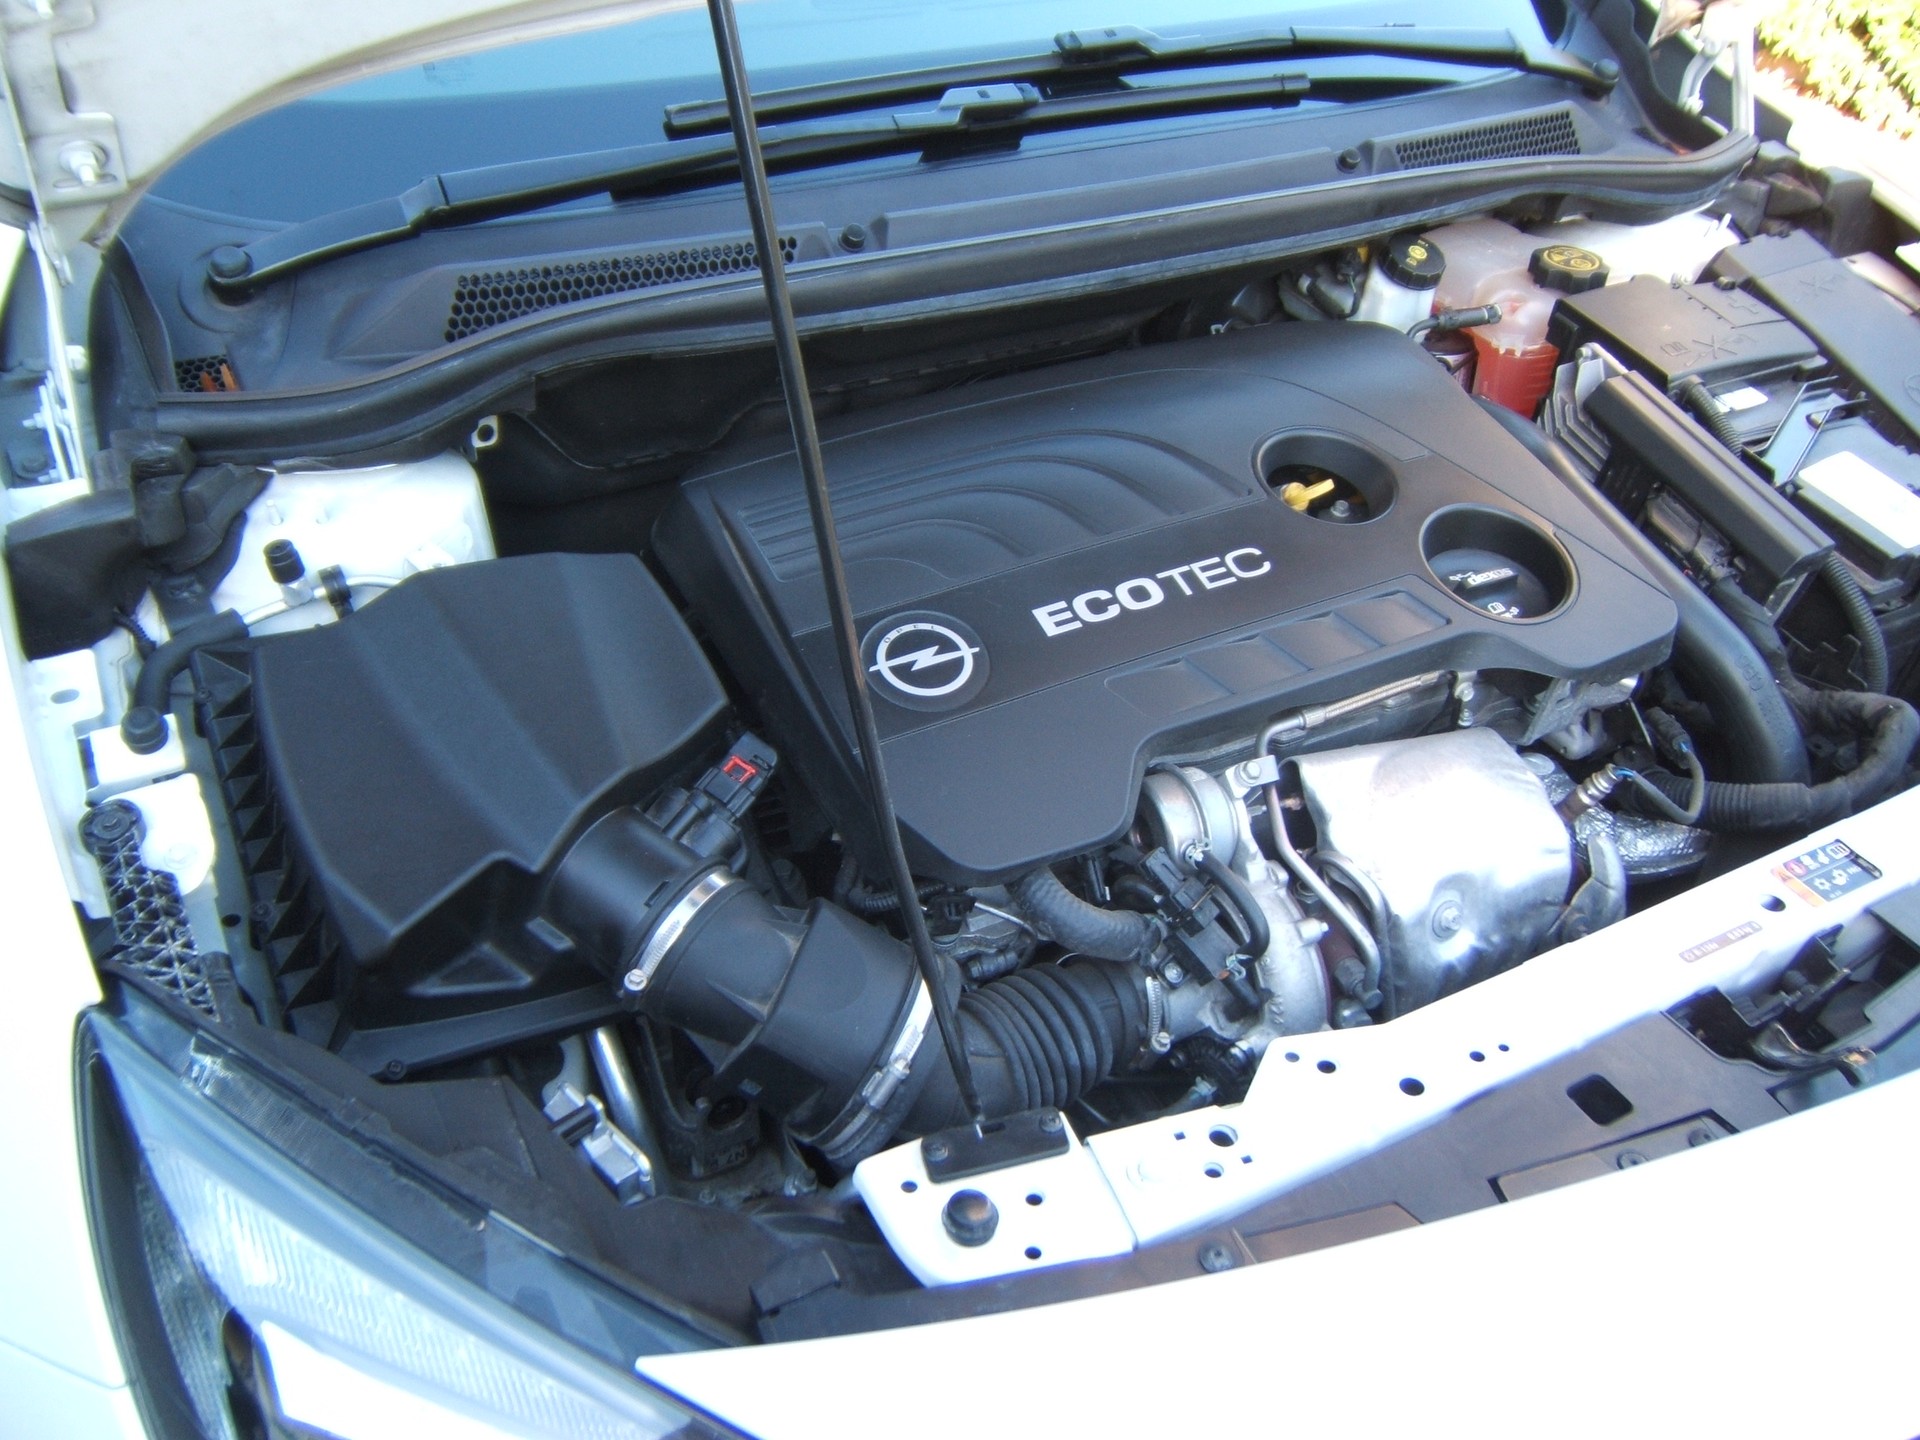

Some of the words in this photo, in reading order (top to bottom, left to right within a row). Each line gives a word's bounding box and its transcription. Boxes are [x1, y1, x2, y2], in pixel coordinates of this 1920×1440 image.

[1467, 567, 1514, 585] dexos
[1031, 547, 1271, 637] ECOTEC
[883, 624, 935, 644] OPEL
